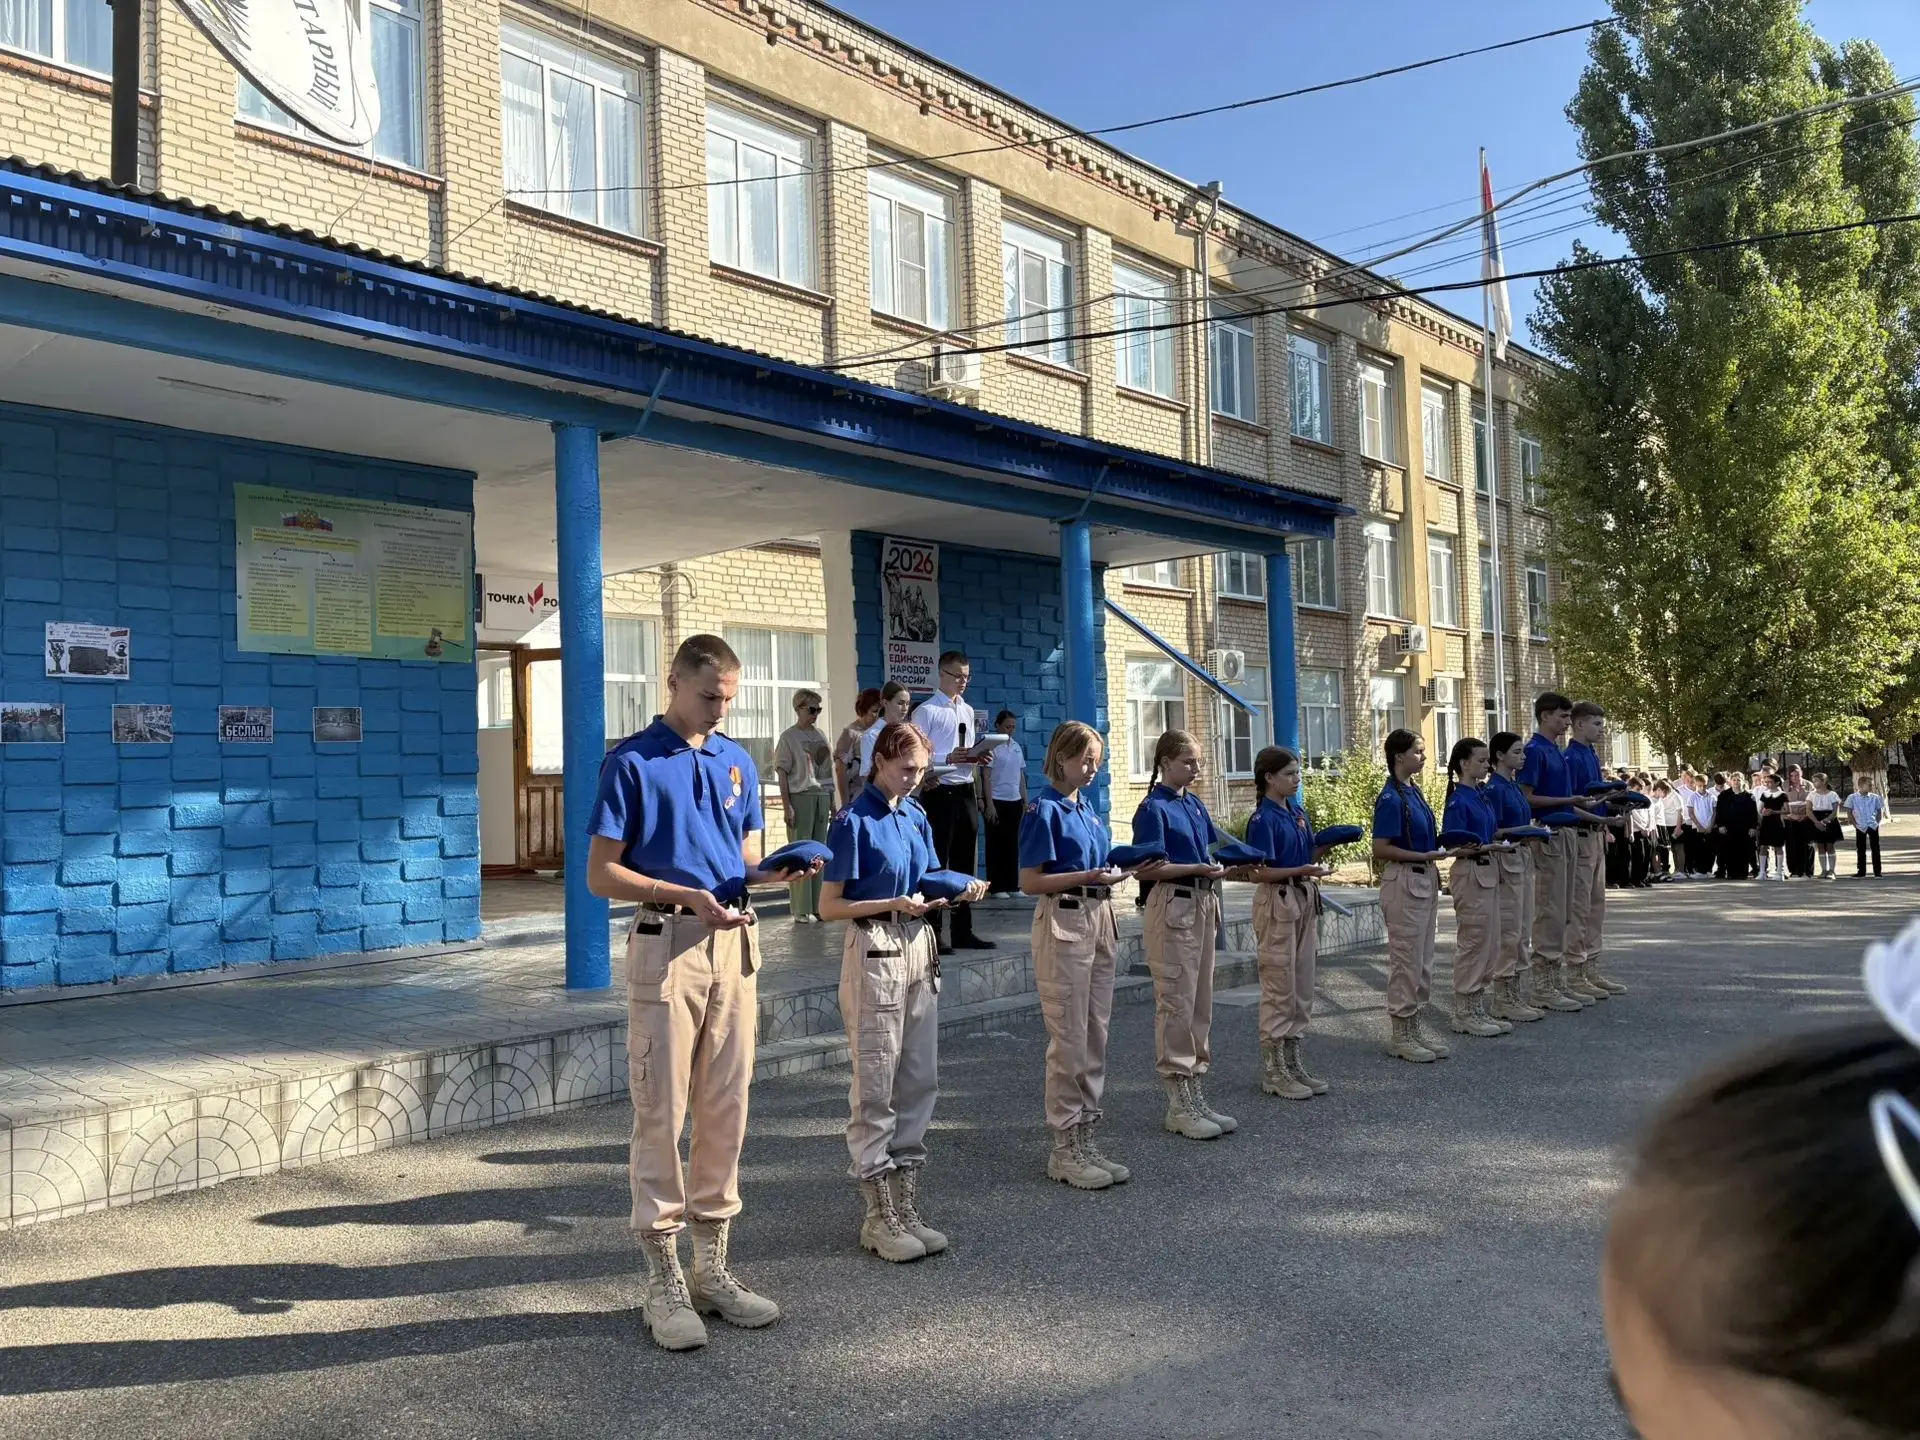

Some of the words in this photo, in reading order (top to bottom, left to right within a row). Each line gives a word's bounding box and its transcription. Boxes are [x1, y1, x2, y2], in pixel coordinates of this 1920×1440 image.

[888, 546, 934, 575] 2026
[487, 592, 525, 605] ТОЧКА
[888, 643, 907, 654] ГОД
[889, 654, 934, 665] ЕДИНСТВА
[890, 664, 931, 675] НАРОДОВ
[890, 674, 926, 685] РОССИИ
[225, 724, 264, 737] БЕСЛАН
